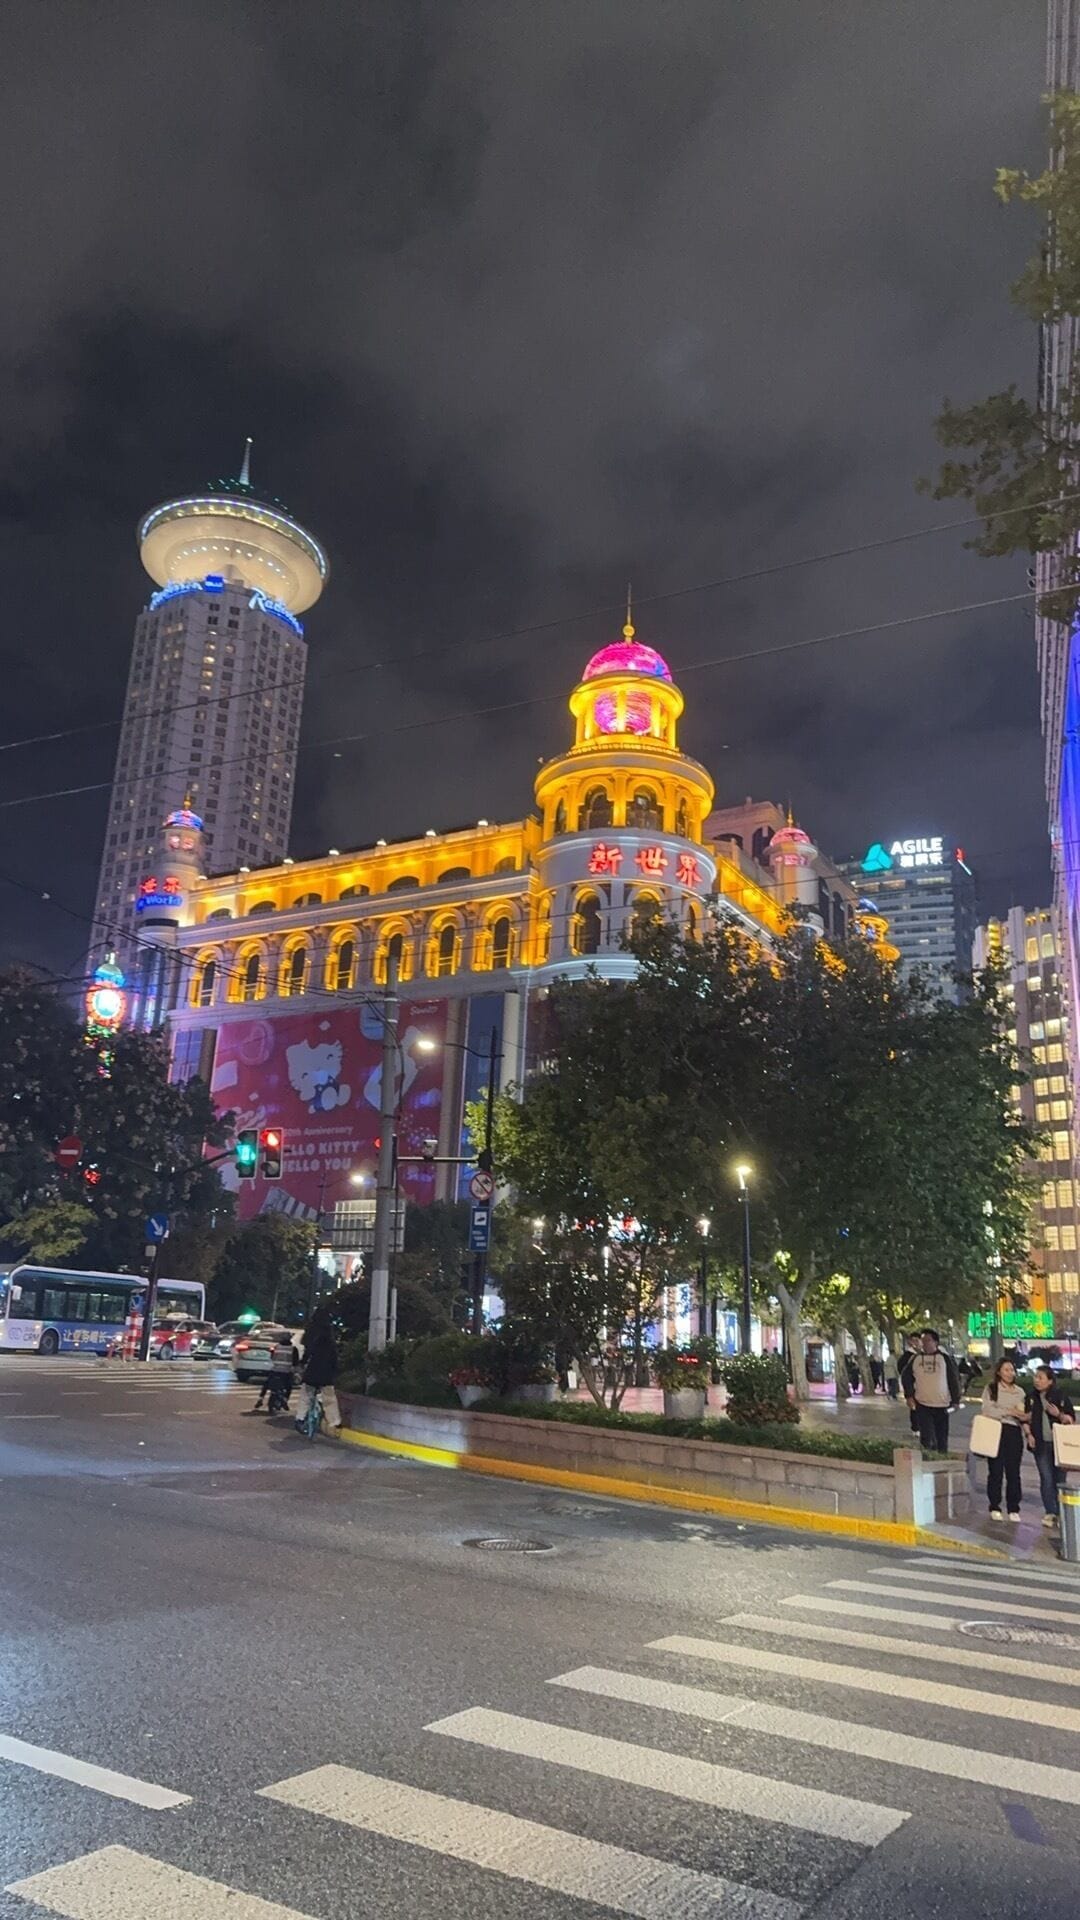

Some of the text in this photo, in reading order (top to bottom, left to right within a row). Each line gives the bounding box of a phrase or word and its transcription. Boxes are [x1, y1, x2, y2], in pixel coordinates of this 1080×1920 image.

[890, 837, 943, 855] AGILE
[588, 843, 703, 888] 新世界
[283, 1140, 360, 1156] ELLO KITTY
[324, 1157, 352, 1170] YOU
